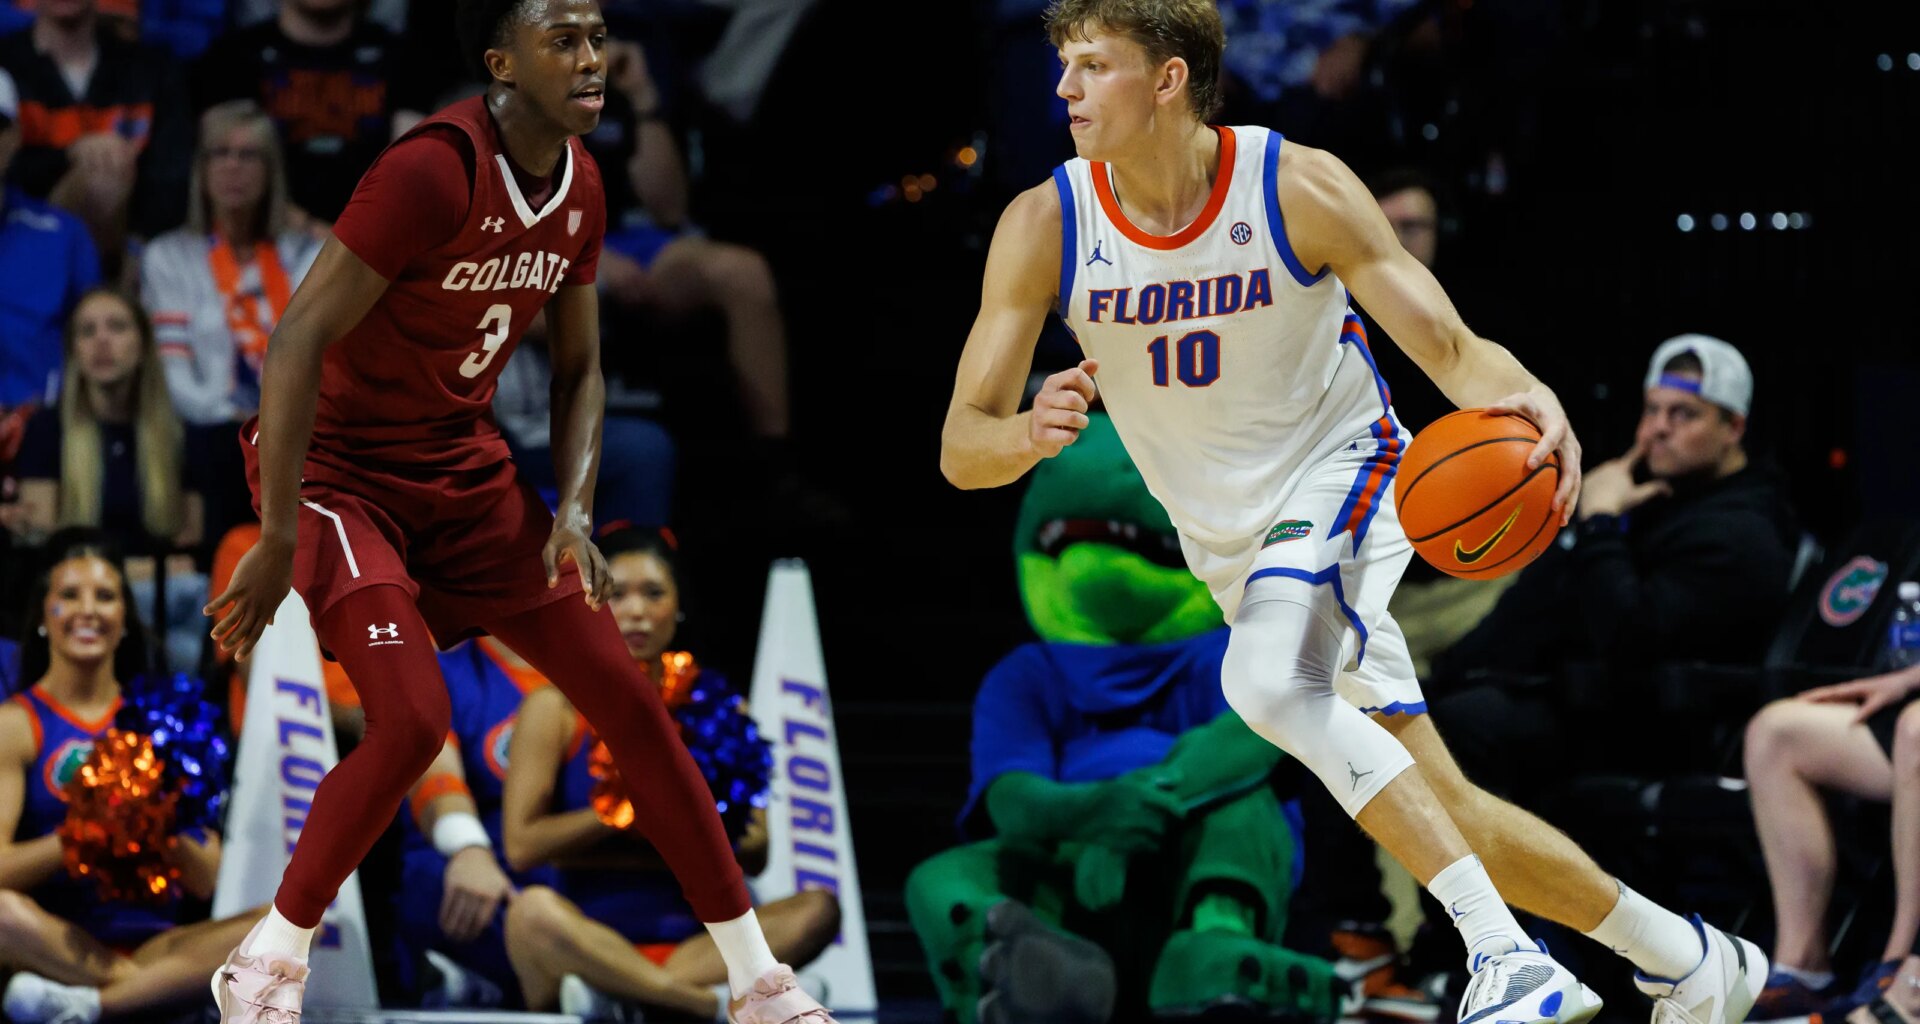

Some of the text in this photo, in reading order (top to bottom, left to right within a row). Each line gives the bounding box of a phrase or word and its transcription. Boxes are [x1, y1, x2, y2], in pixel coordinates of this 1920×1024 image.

[1231, 223, 1251, 244] SEC
[441, 250, 570, 294] COLGATE
[1086, 268, 1274, 326] FLORIDA
[458, 303, 512, 379] 3
[1147, 329, 1221, 388] 10
